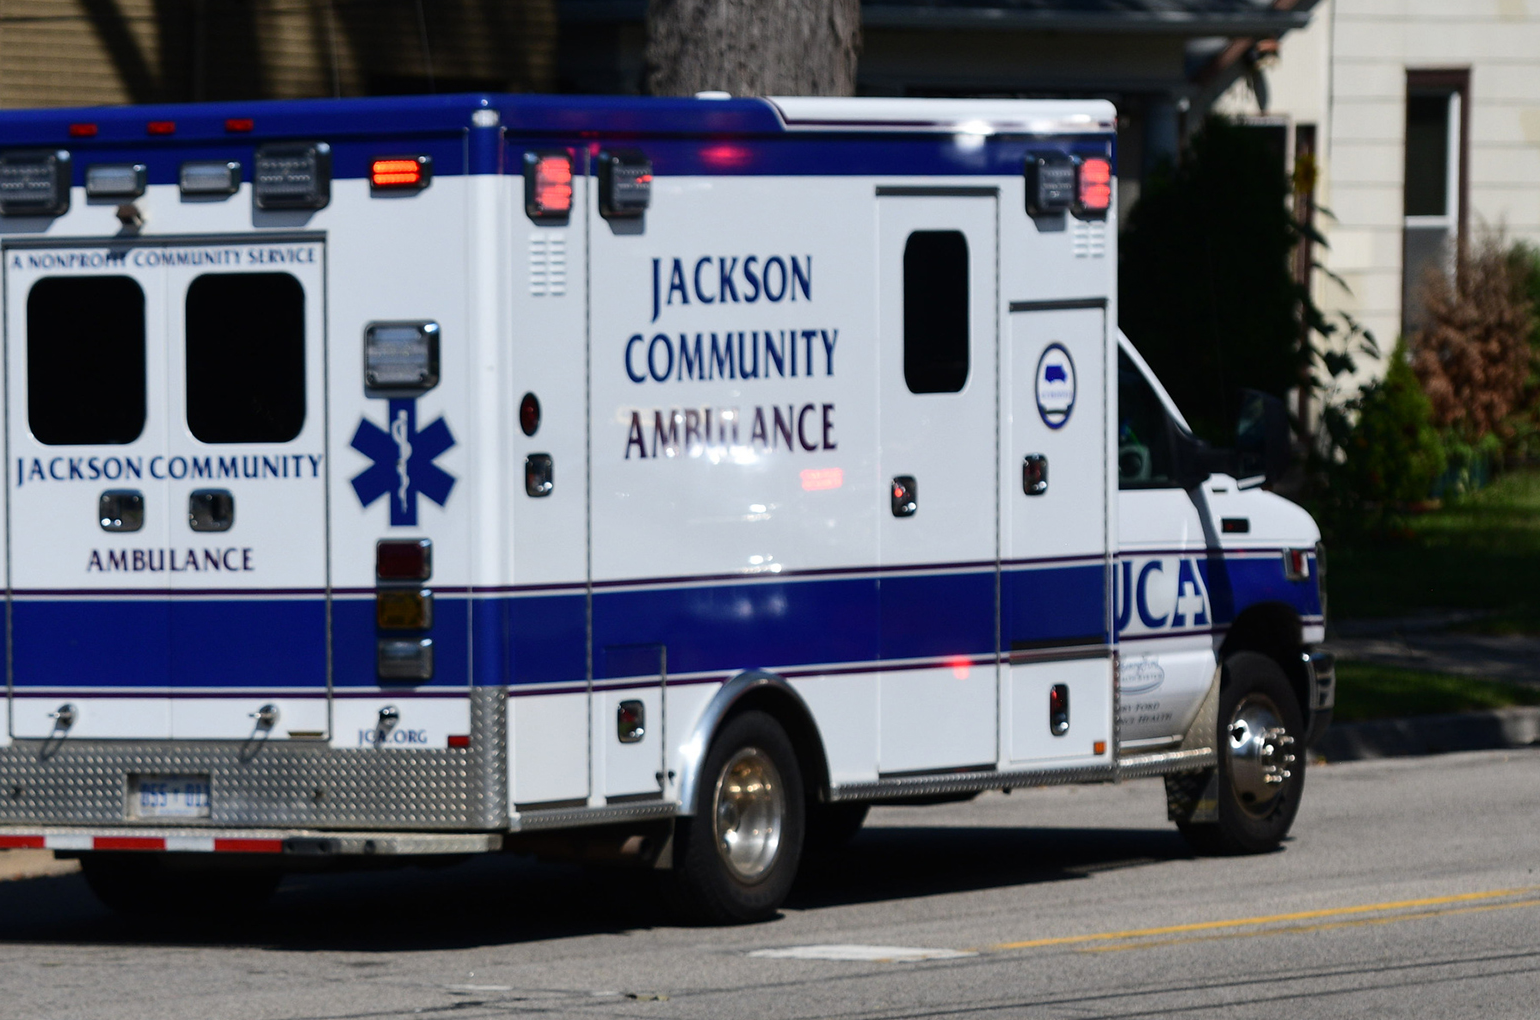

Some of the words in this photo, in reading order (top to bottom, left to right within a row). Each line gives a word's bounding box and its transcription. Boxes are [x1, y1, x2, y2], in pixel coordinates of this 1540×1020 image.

[11, 254, 23, 269] A
[133, 248, 241, 267] COMMUNITY
[248, 247, 315, 265] SERVICE
[650, 254, 813, 324] JACKSON
[625, 328, 839, 384] COMMUNITY
[16, 455, 144, 488] JACKSON
[150, 453, 323, 481] COMMUNITY
[87, 547, 256, 573] AMBULANCE
